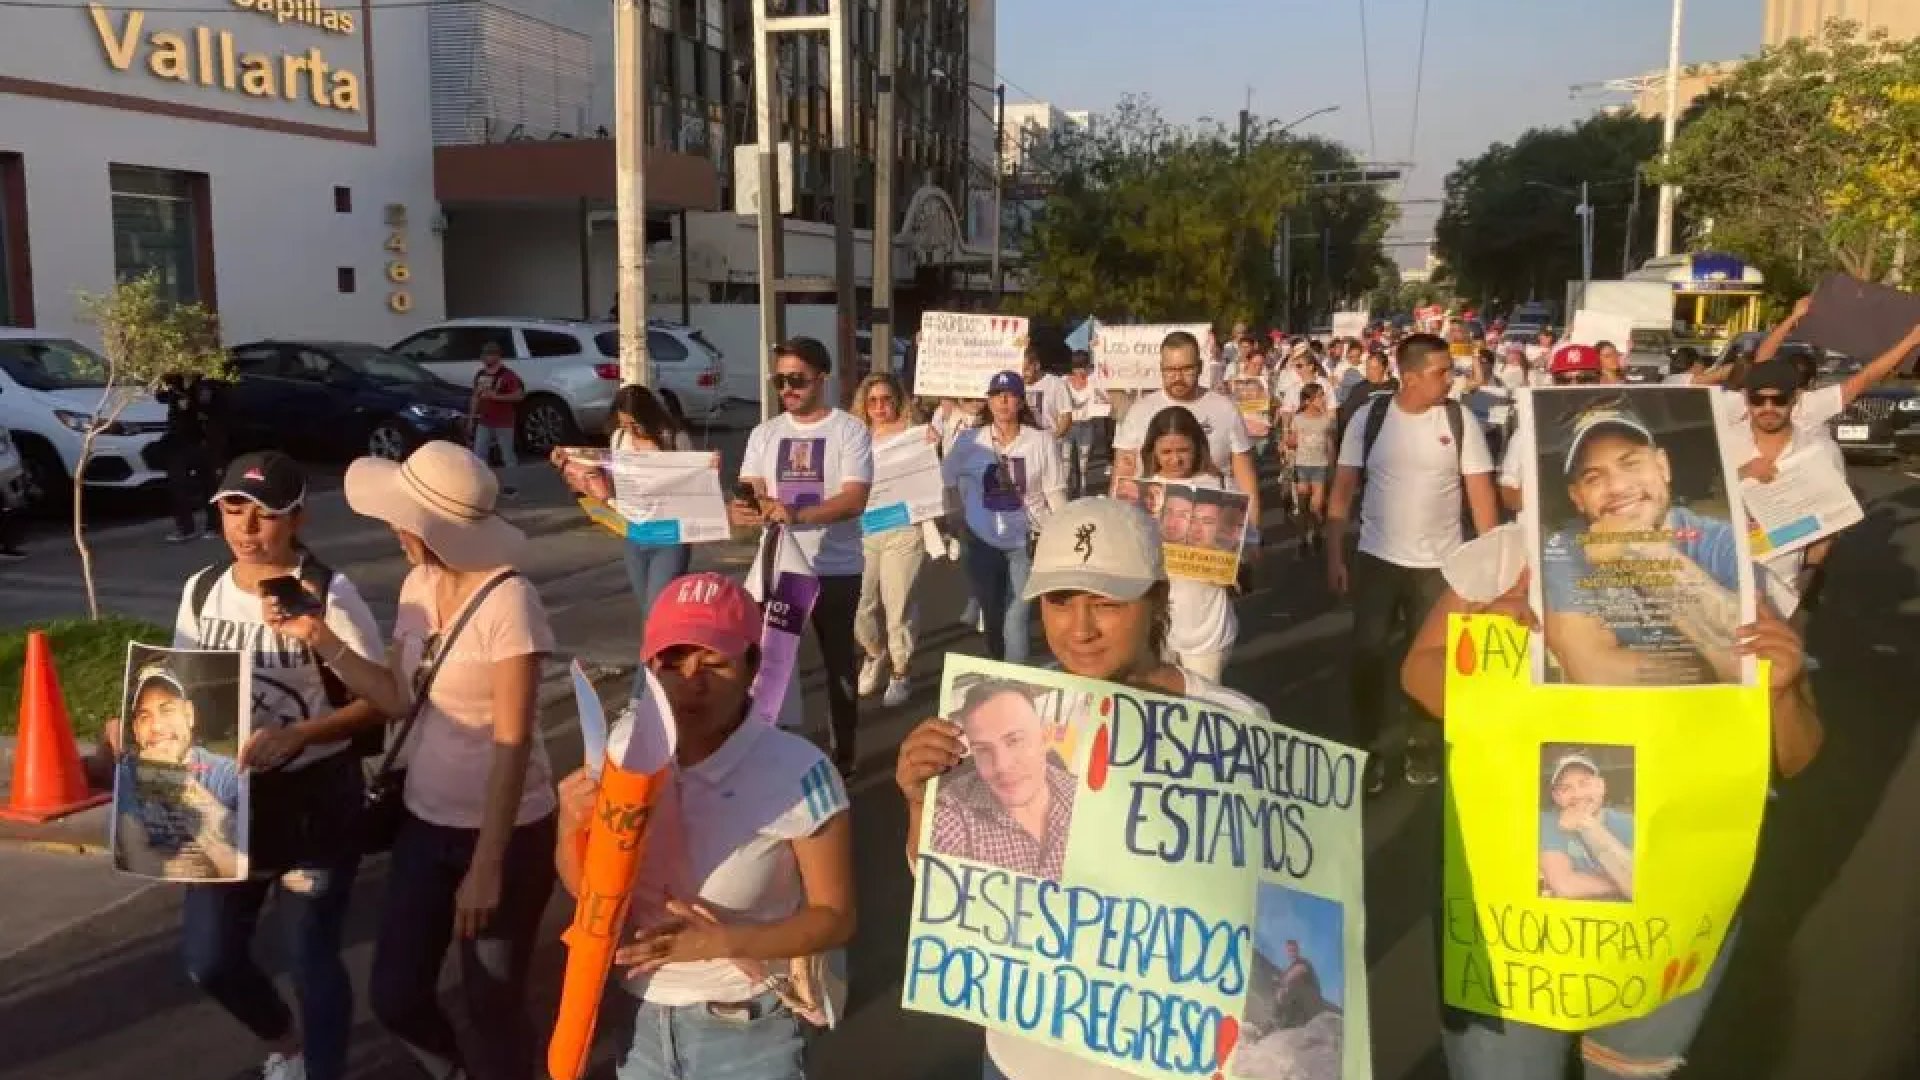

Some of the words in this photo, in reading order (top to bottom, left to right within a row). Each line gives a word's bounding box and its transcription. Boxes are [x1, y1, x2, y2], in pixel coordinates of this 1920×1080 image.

[86, 3, 361, 111] Vallarta
[233, 0, 355, 34] apillas
[384, 203, 410, 314] 460
[677, 579, 719, 605] GAP
[1087, 693, 1357, 810] ¡DESAPARECIDO
[1125, 781, 1314, 879] ESTAMOS
[916, 853, 1251, 996] DESESPERADOS
[1447, 898, 1673, 961] ENCONTRAR
[1051, 964, 1240, 1080] REGRESO!
